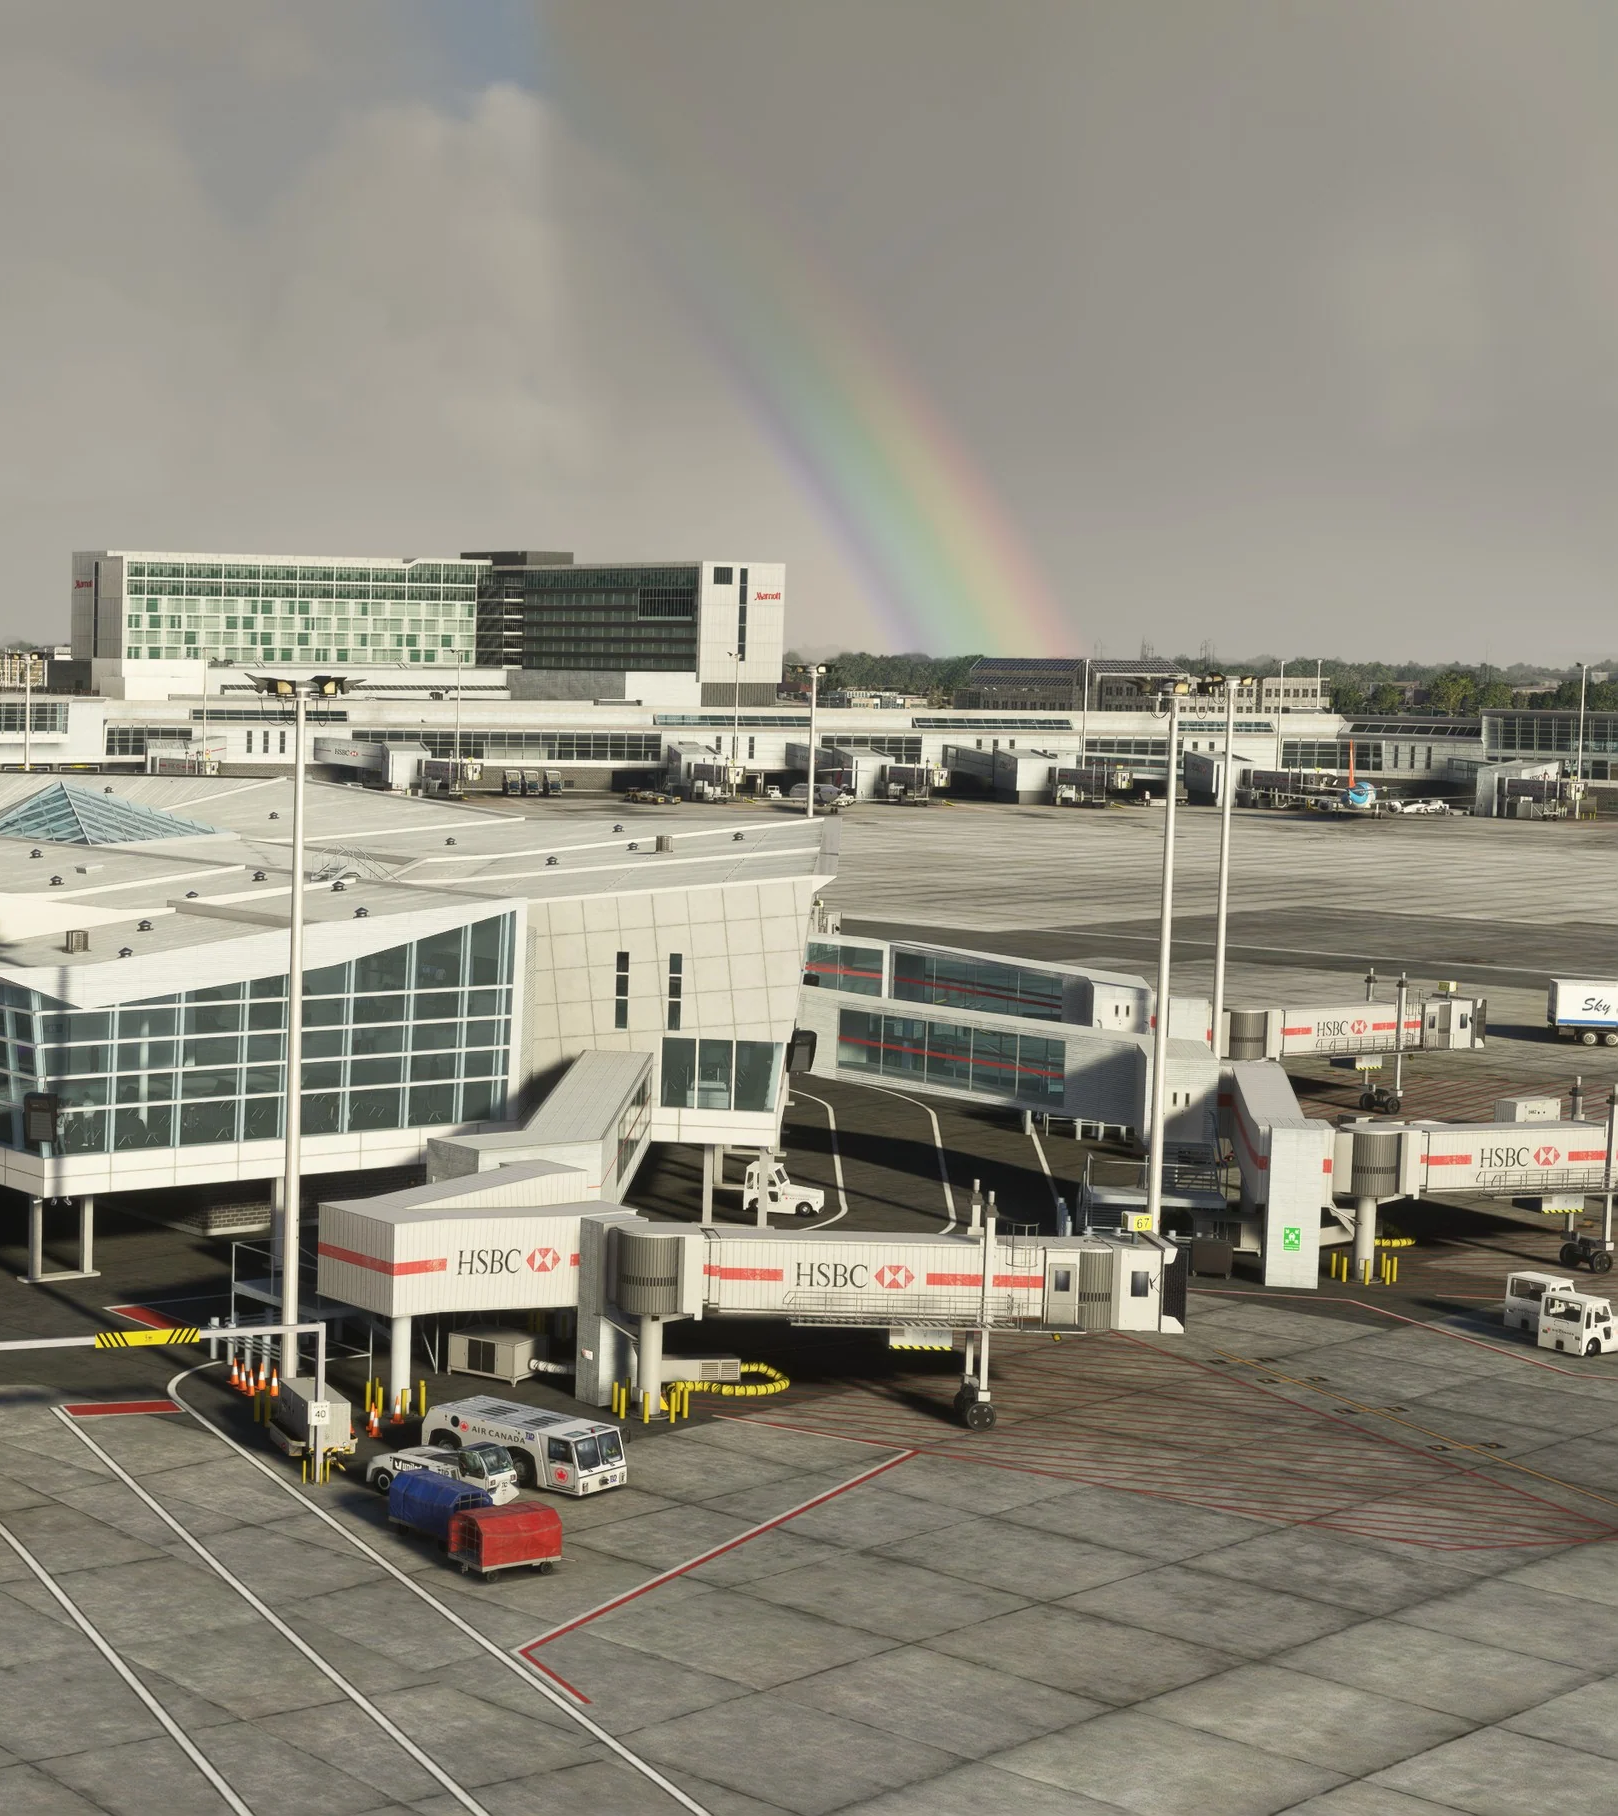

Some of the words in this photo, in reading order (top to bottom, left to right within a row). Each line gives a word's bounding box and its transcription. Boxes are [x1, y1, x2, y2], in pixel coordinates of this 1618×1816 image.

[754, 591, 781, 600] Marriott
[1582, 998, 1611, 1015] Sky
[1316, 1020, 1349, 1037] HSBC
[1480, 1147, 1530, 1169] HSBC
[1136, 1218, 1150, 1229] 67
[457, 1248, 522, 1276] HSBC
[795, 1262, 869, 1289] HSBC
[315, 1410, 327, 1418] 40
[471, 1425, 487, 1436] AIR
[488, 1429, 526, 1445] CANADA
